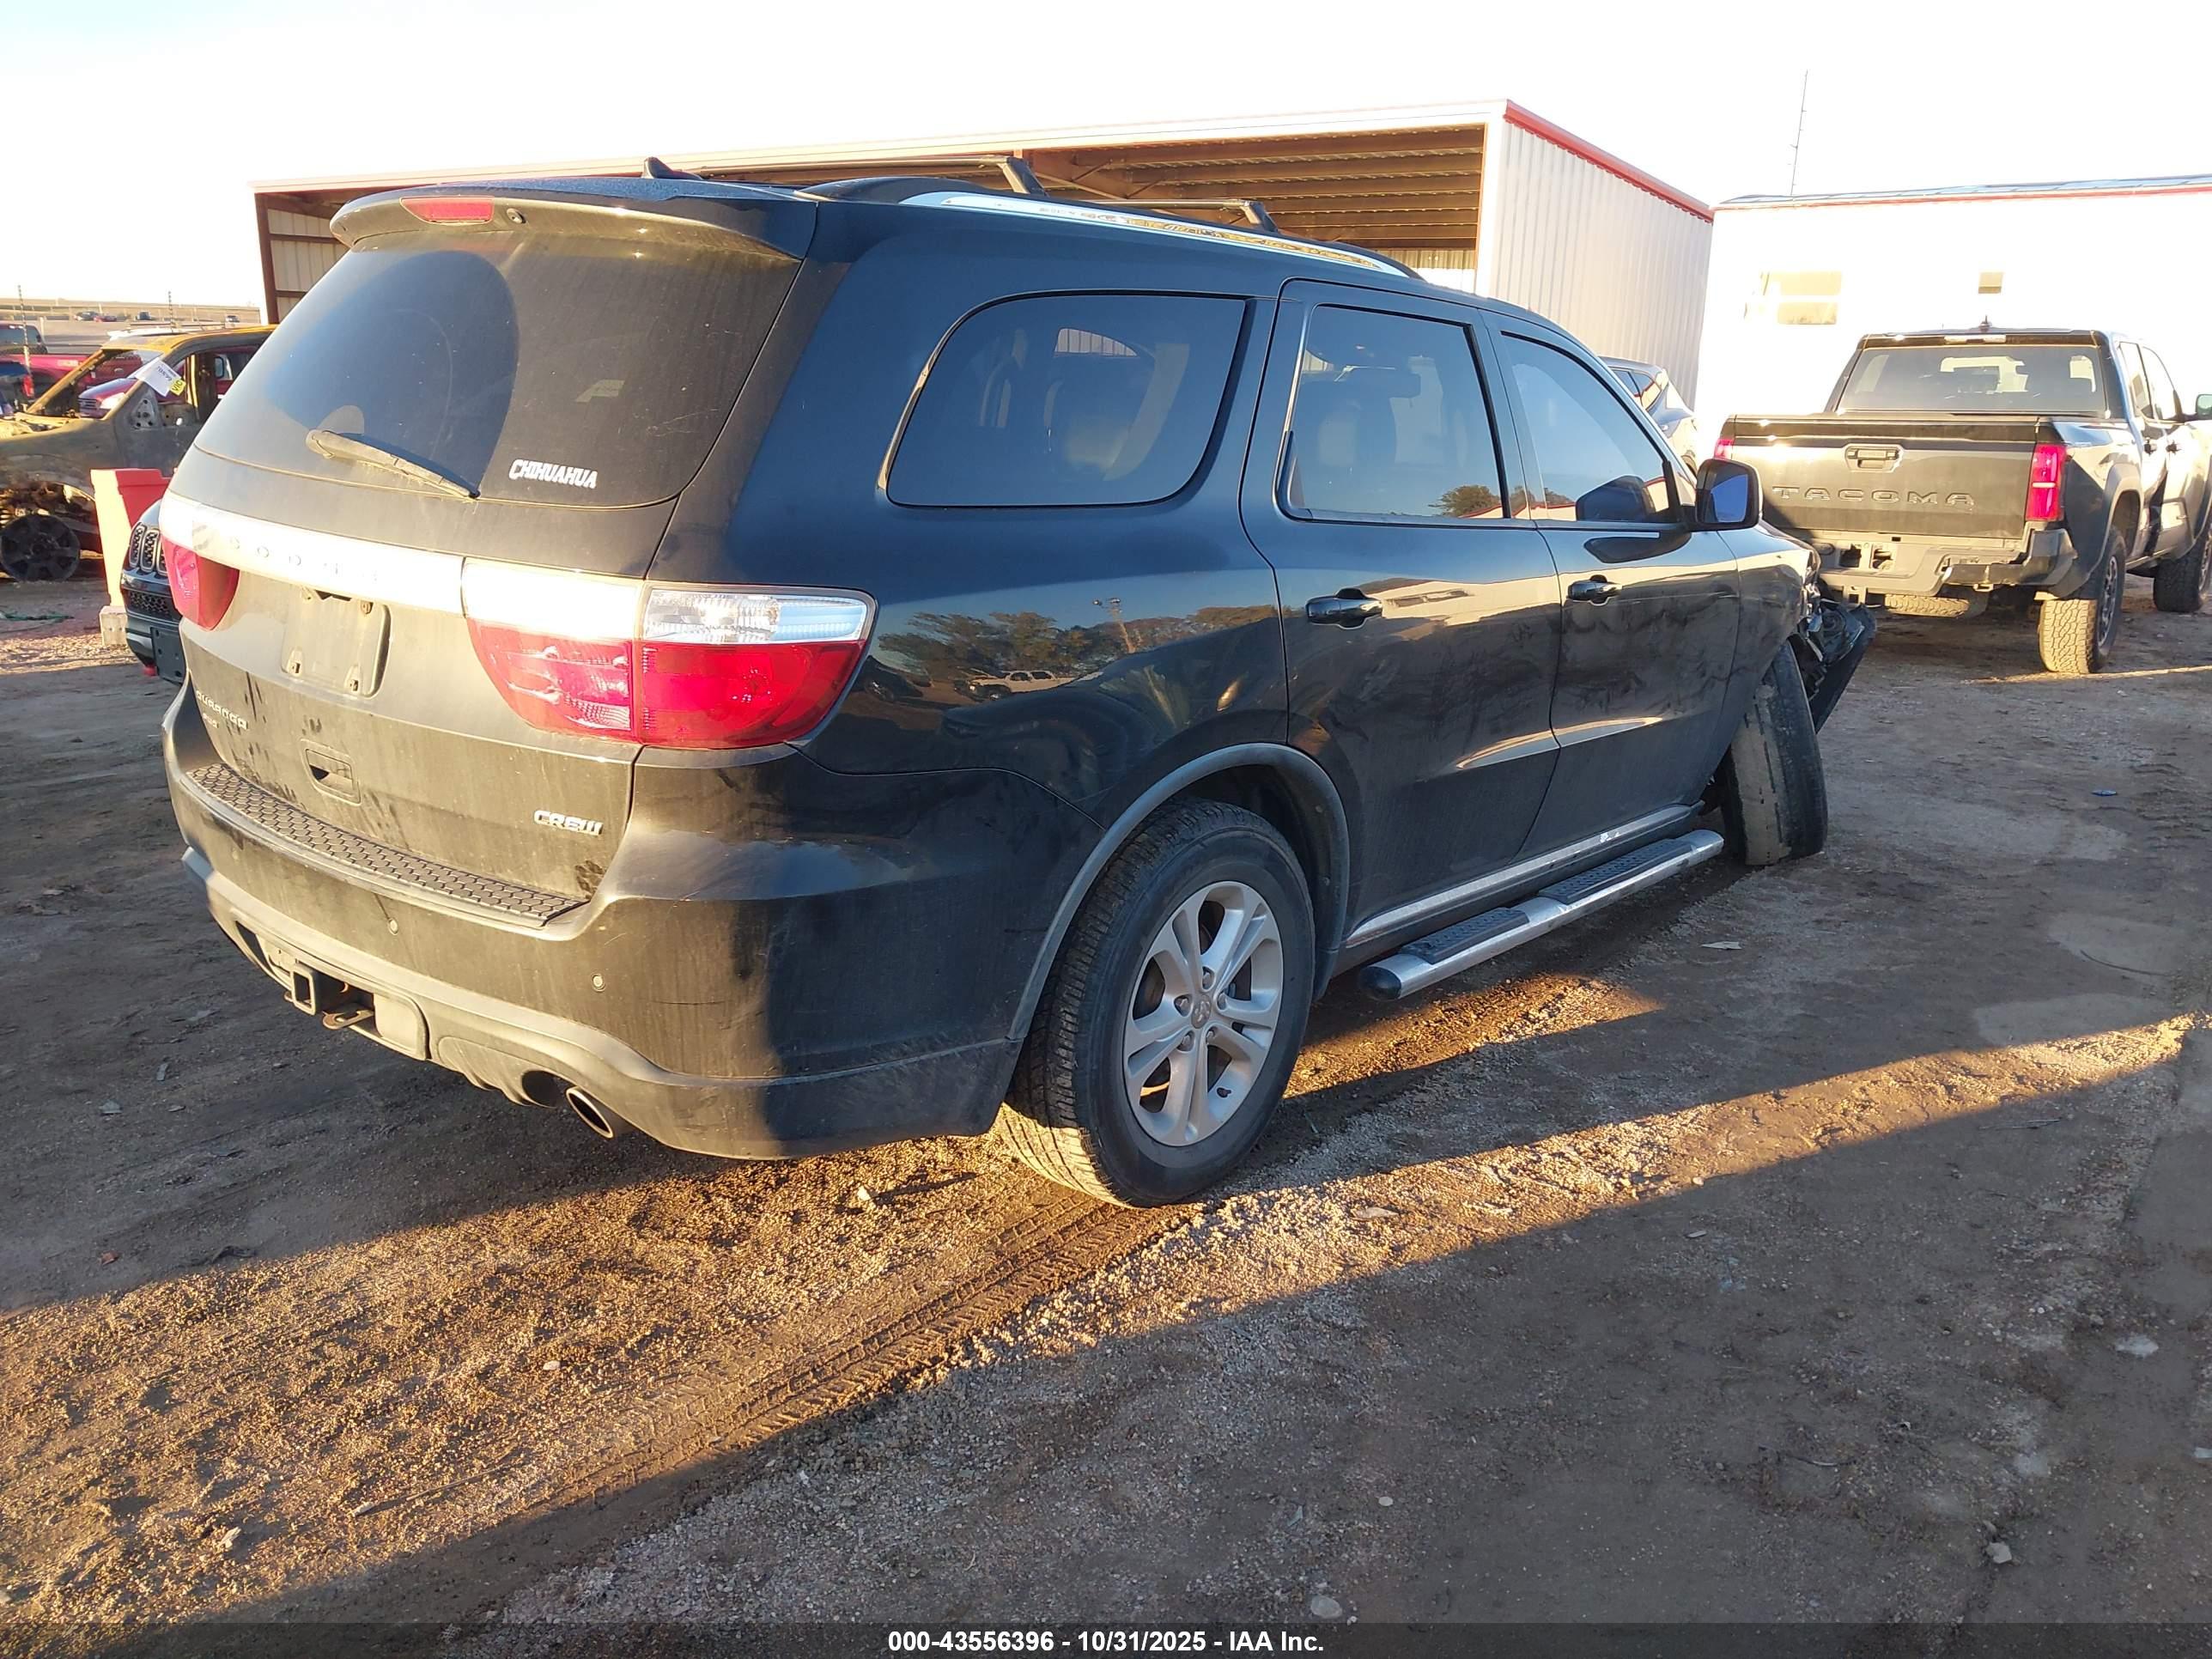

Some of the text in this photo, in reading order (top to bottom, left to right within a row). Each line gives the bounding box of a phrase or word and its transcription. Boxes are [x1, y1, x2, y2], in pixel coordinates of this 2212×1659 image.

[508, 459, 599, 489] CHIHUAHUA
[1771, 485, 1975, 510] TACOMA
[196, 690, 247, 730] DURANGO
[533, 810, 605, 836] CREW
